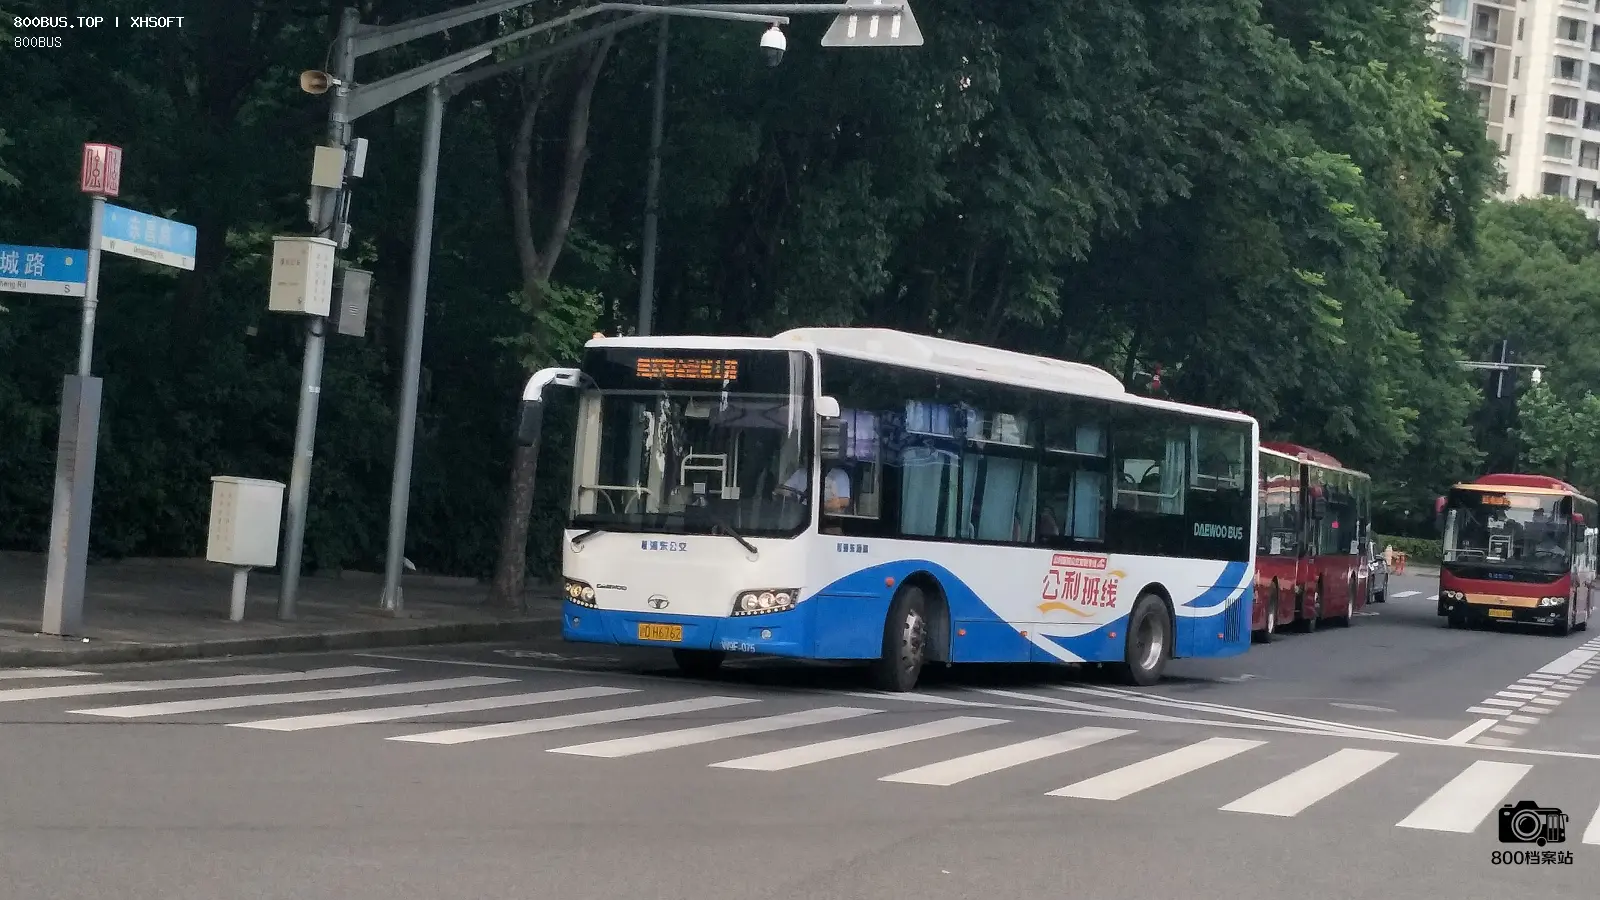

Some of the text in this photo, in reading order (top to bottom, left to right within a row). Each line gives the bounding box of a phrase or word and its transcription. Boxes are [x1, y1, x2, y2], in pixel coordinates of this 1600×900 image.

[0, 250, 45, 277] 城路
[64, 284, 71, 294] S
[1193, 522, 1243, 540] DAEWOO BUS
[1042, 569, 1119, 609] 公利班线
